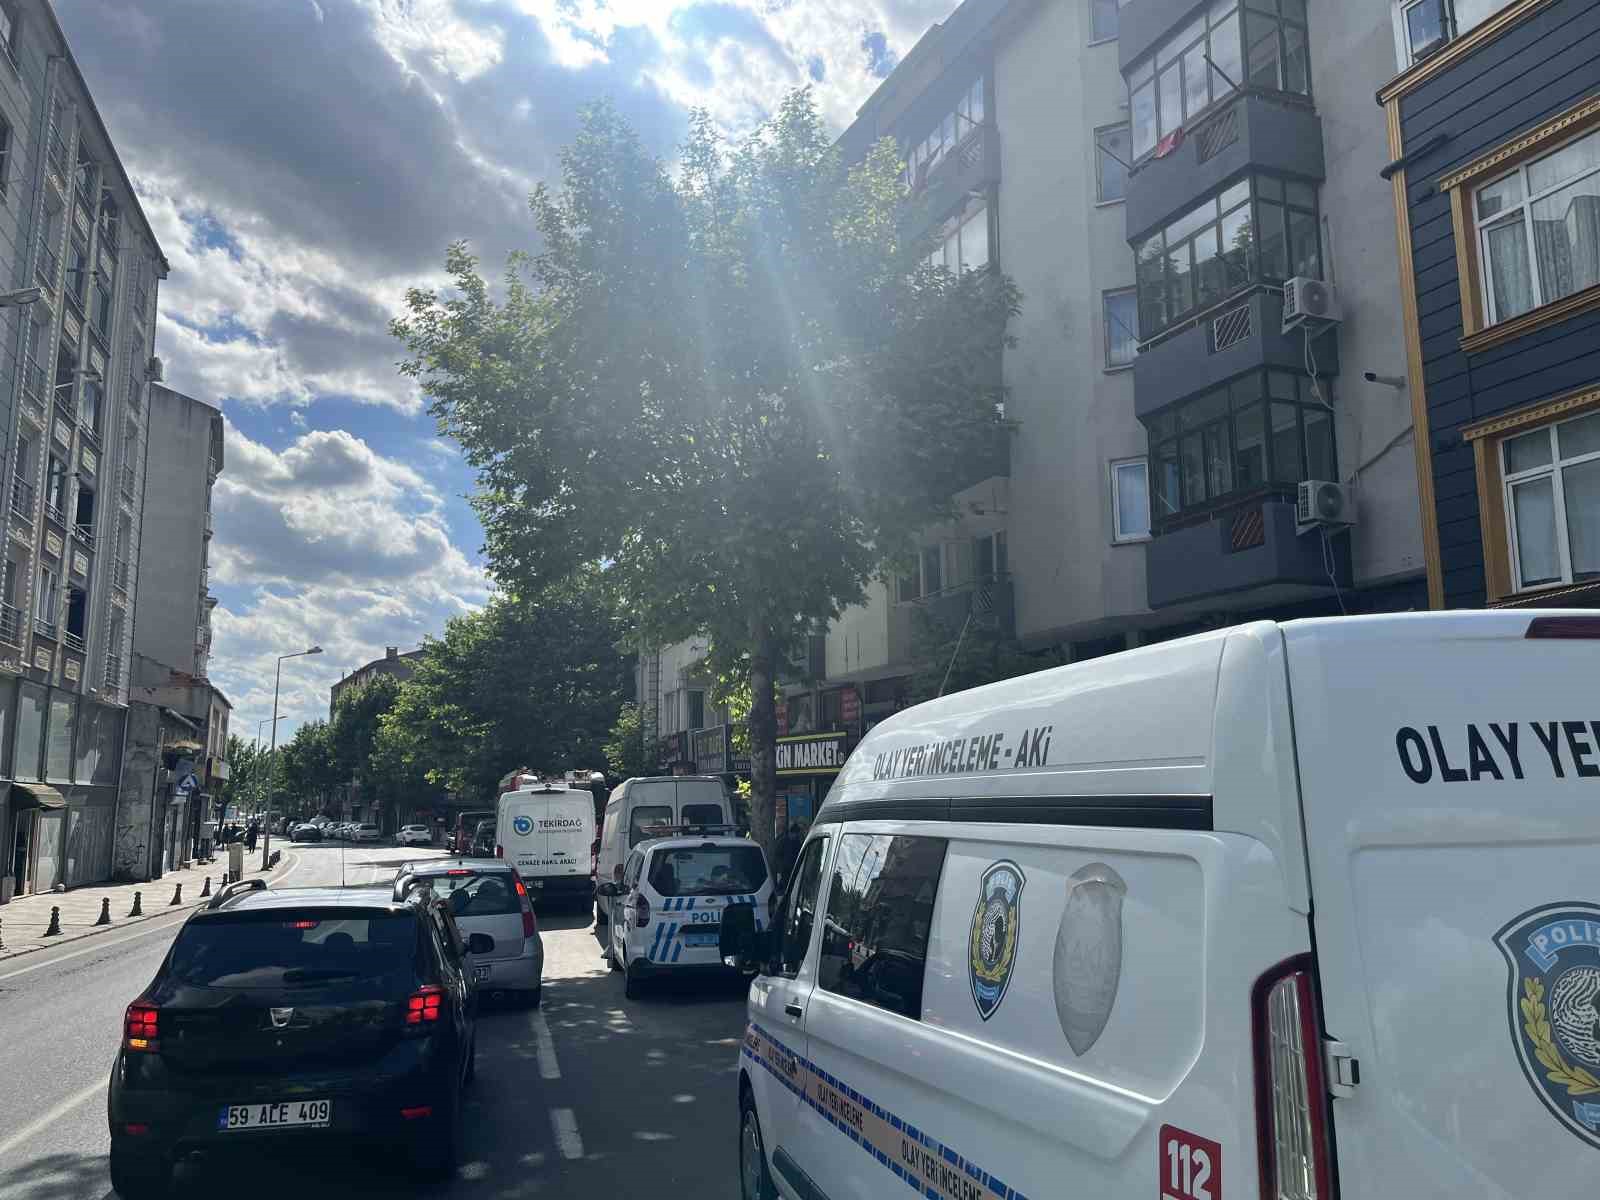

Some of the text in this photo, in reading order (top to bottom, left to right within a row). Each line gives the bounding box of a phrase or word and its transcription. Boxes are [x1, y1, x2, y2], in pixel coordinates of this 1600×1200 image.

[794, 741, 839, 768] MARKET
[873, 750, 902, 782] OLAY
[1396, 720, 1600, 784] OLAY YE
[229, 1107, 249, 1126] 59
[298, 1101, 329, 1121] 409
[902, 1139, 920, 1169] OLAY
[1167, 1139, 1212, 1200] 112
